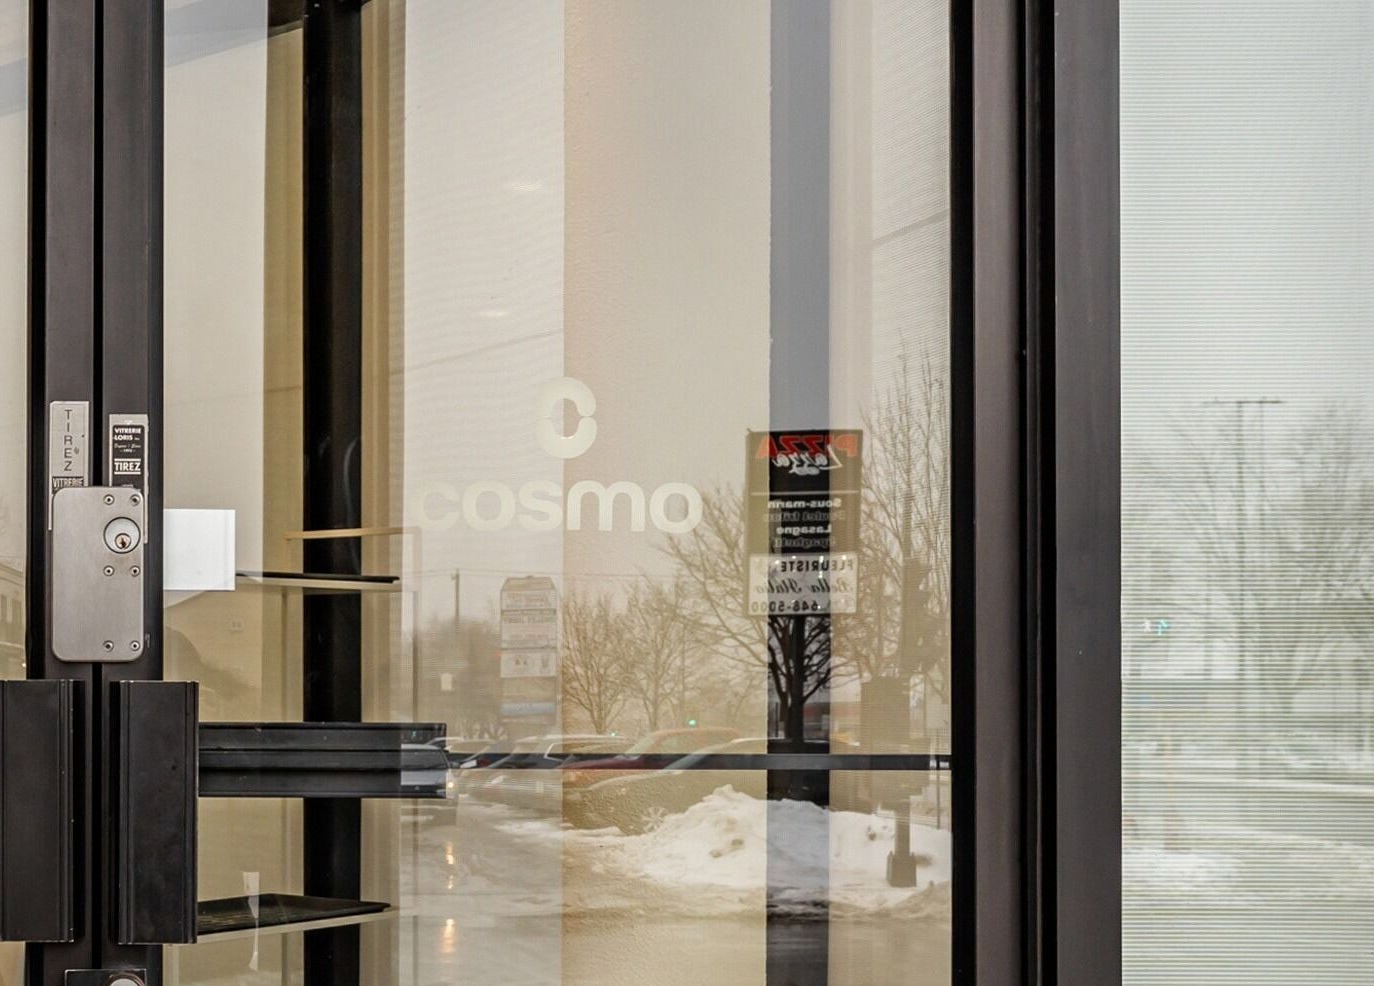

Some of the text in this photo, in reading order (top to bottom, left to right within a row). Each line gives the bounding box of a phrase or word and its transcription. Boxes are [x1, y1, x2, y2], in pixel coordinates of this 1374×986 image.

[63, 409, 73, 472] TIREZ
[114, 462, 141, 471] TIREZ
[418, 480, 703, 534] cosmo
